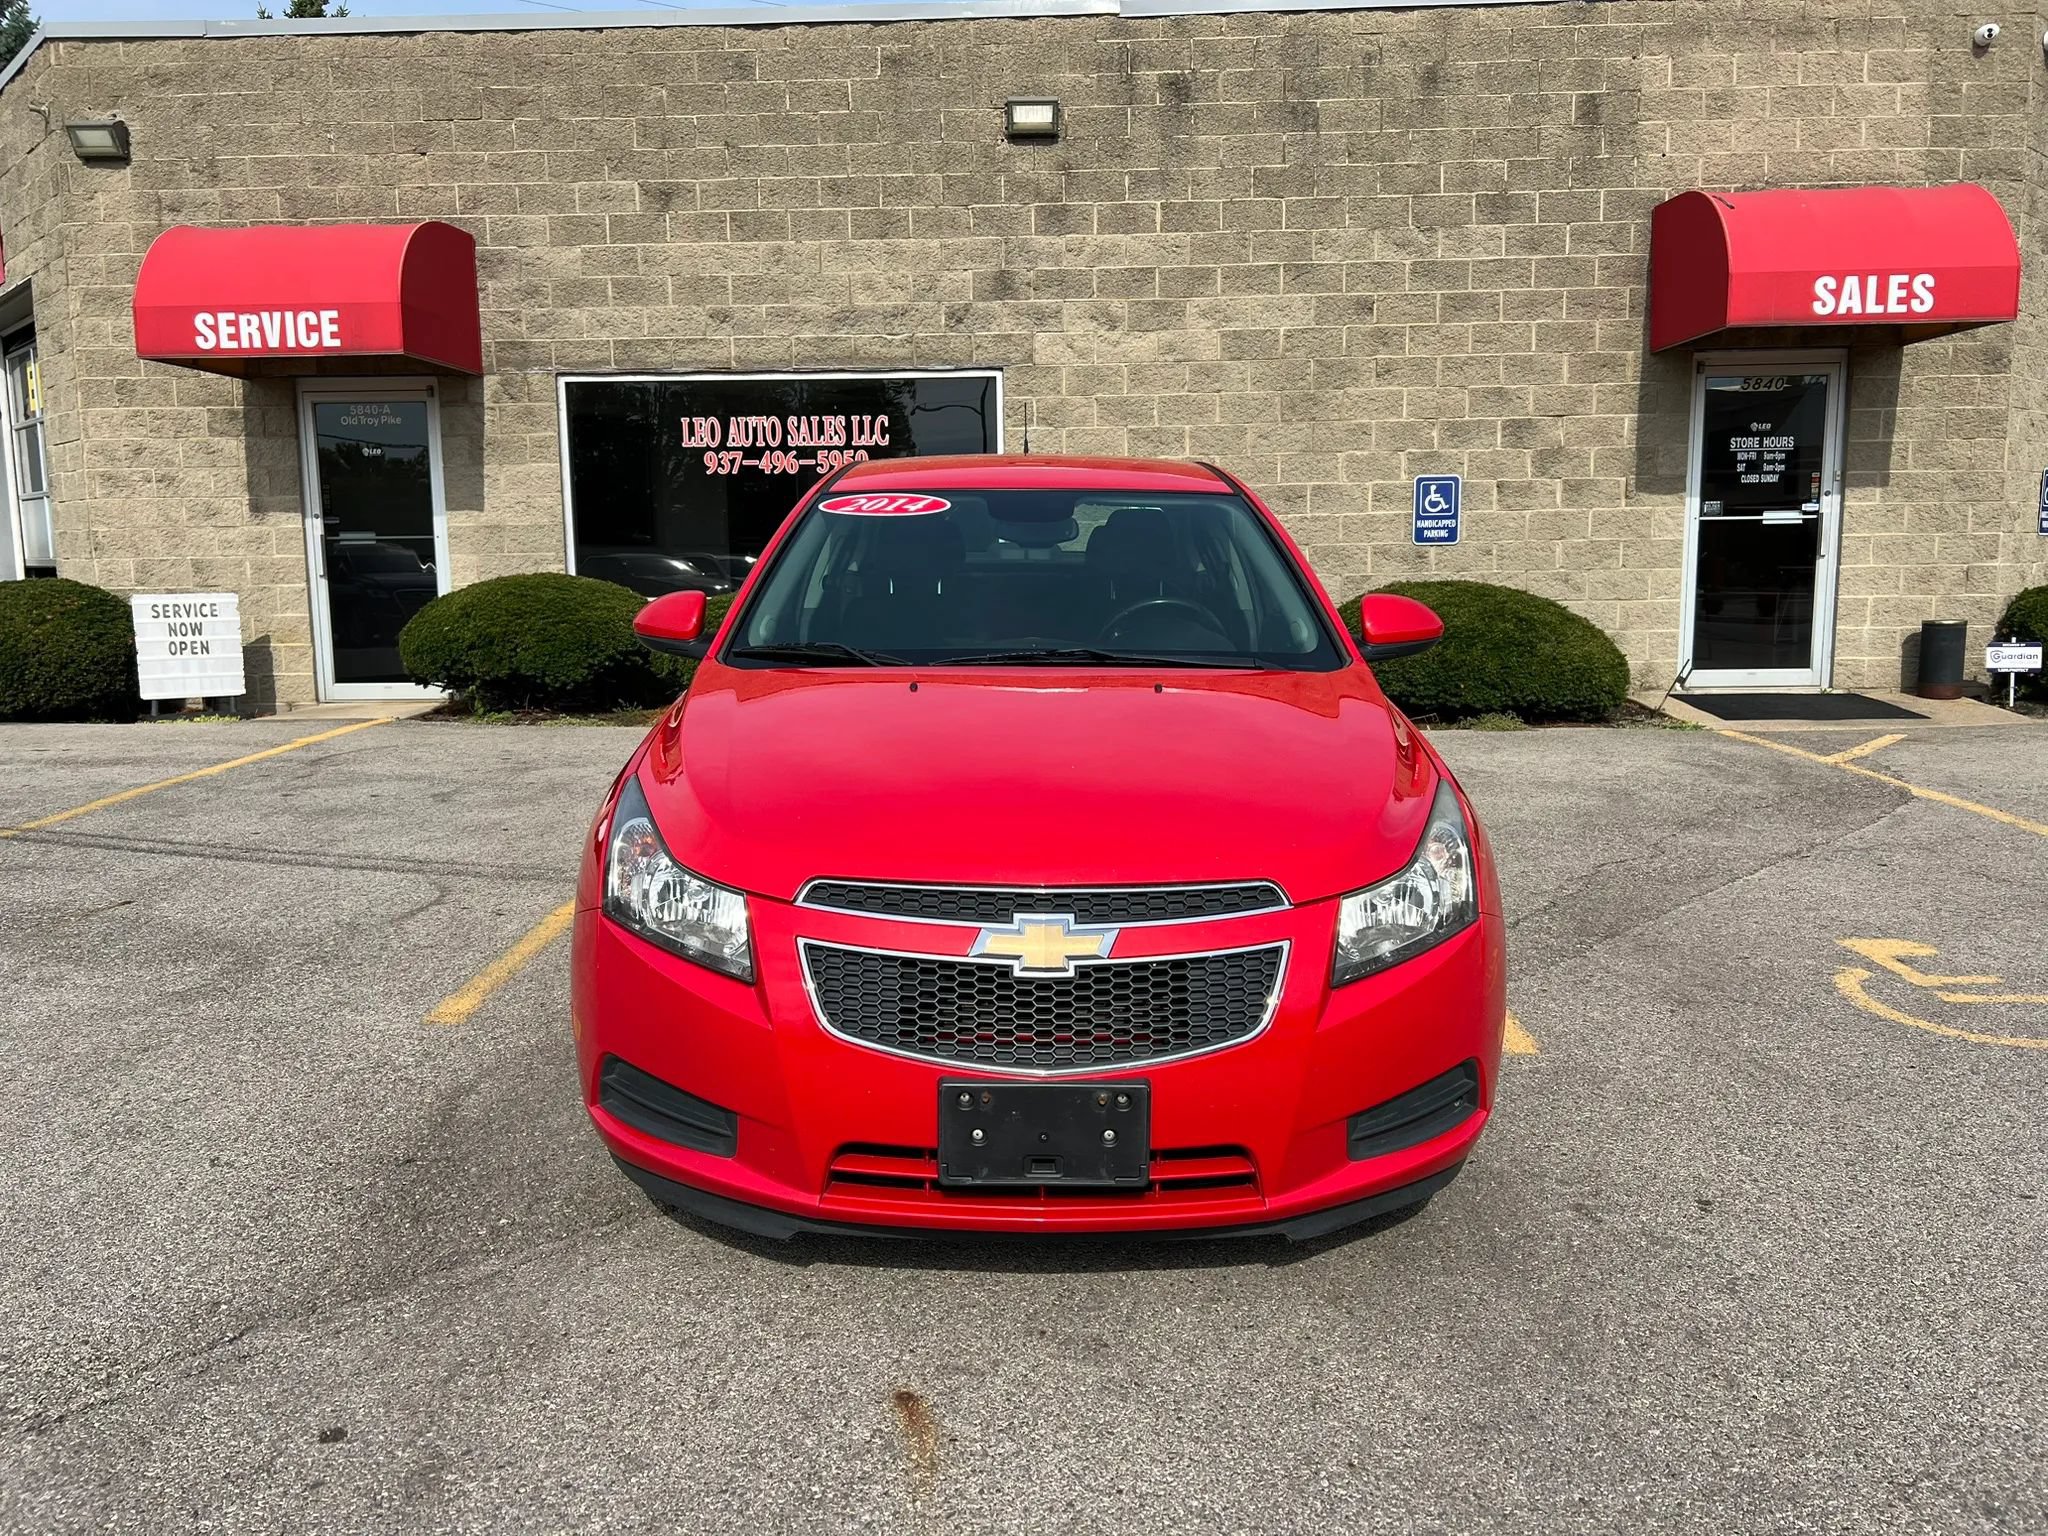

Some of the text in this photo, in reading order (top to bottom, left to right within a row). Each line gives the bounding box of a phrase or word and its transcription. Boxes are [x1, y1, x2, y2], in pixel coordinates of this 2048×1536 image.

[1812, 273, 1935, 316] SALES
[194, 310, 341, 350] SERVICE
[1740, 377, 1785, 390] 5840
[349, 404, 391, 415] 5840-A
[340, 415, 402, 427] Old Troy Pike
[681, 415, 889, 448] LEO AUTO SALES LLC
[1730, 436, 1794, 448] STORE HOURS
[1737, 463, 1746, 472] SAT
[1741, 474, 1780, 483] CLOSED SUNDAY
[838, 497, 930, 512] 2014
[1416, 519, 1456, 528] HANDICAPPED
[1423, 529, 1449, 538] PARKING
[151, 602, 219, 619] SERVICE
[168, 621, 203, 637] NOW
[168, 640, 210, 656] OPEN
[1993, 652, 2038, 660] Guardian
